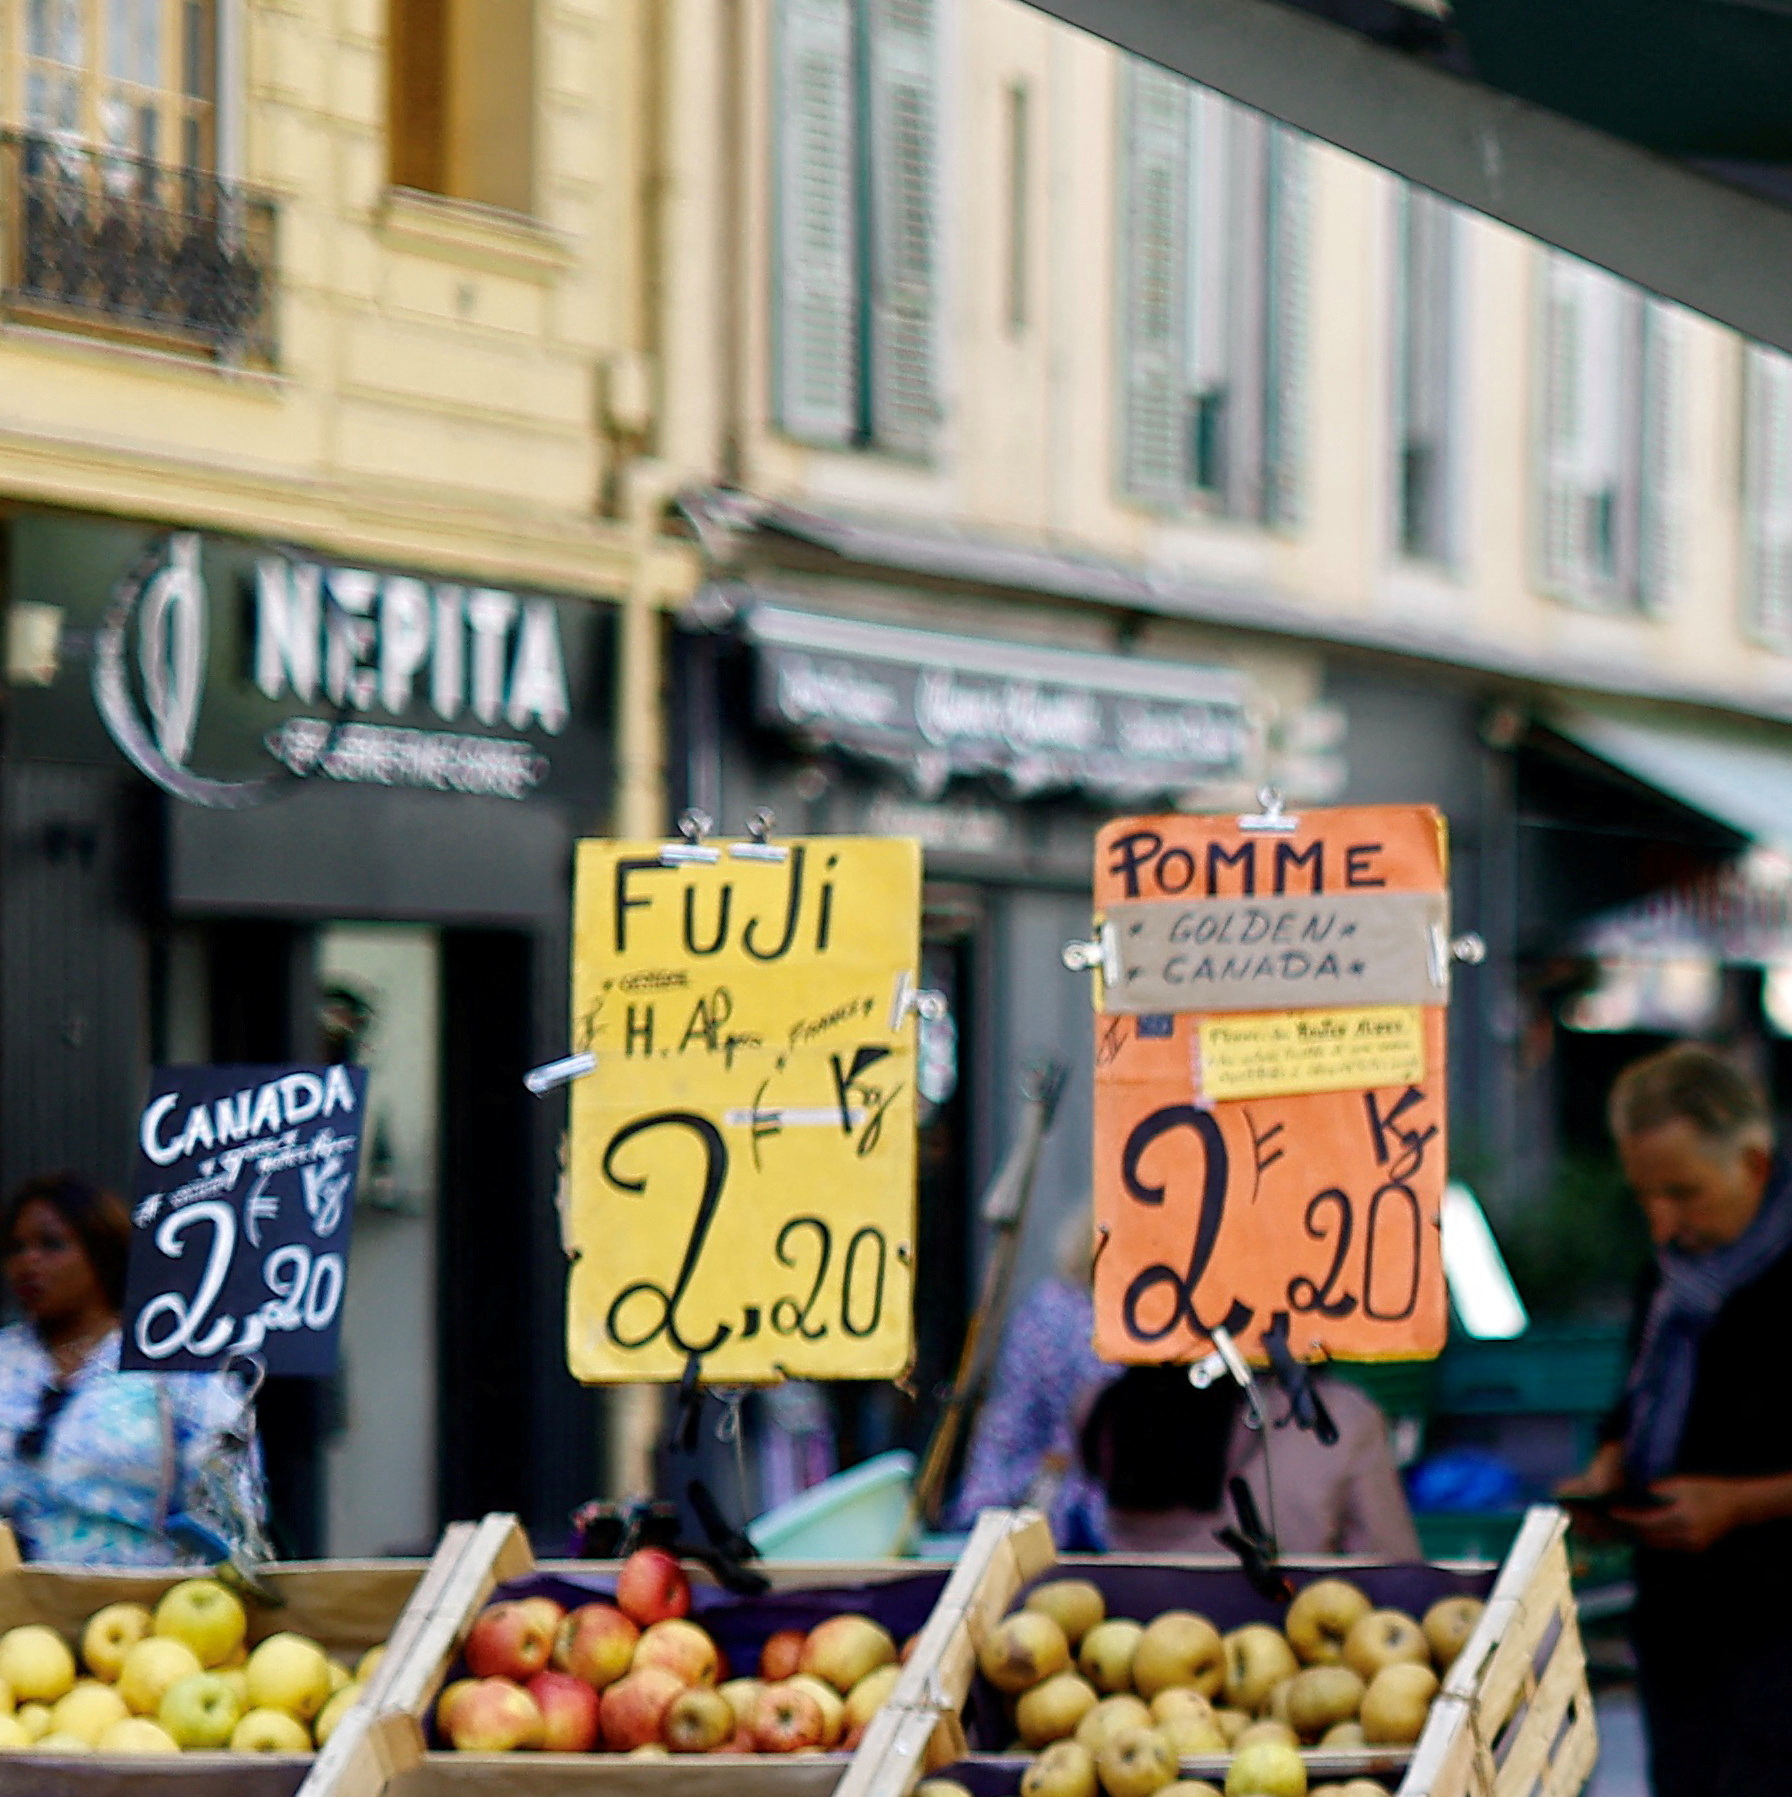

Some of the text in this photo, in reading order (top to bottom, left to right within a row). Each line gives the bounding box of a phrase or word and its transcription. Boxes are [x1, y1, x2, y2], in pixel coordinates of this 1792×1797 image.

[255, 556, 570, 737] NEPITA
[1108, 831, 1387, 897] POMME
[1162, 950, 1342, 985] CANADA
[1169, 908, 1335, 944] GOLDEN
[139, 1063, 357, 1167] CANADA
[830, 1044, 904, 1158] Kg
[1363, 1083, 1439, 1184] Kg
[602, 1110, 888, 1356] 2,20
